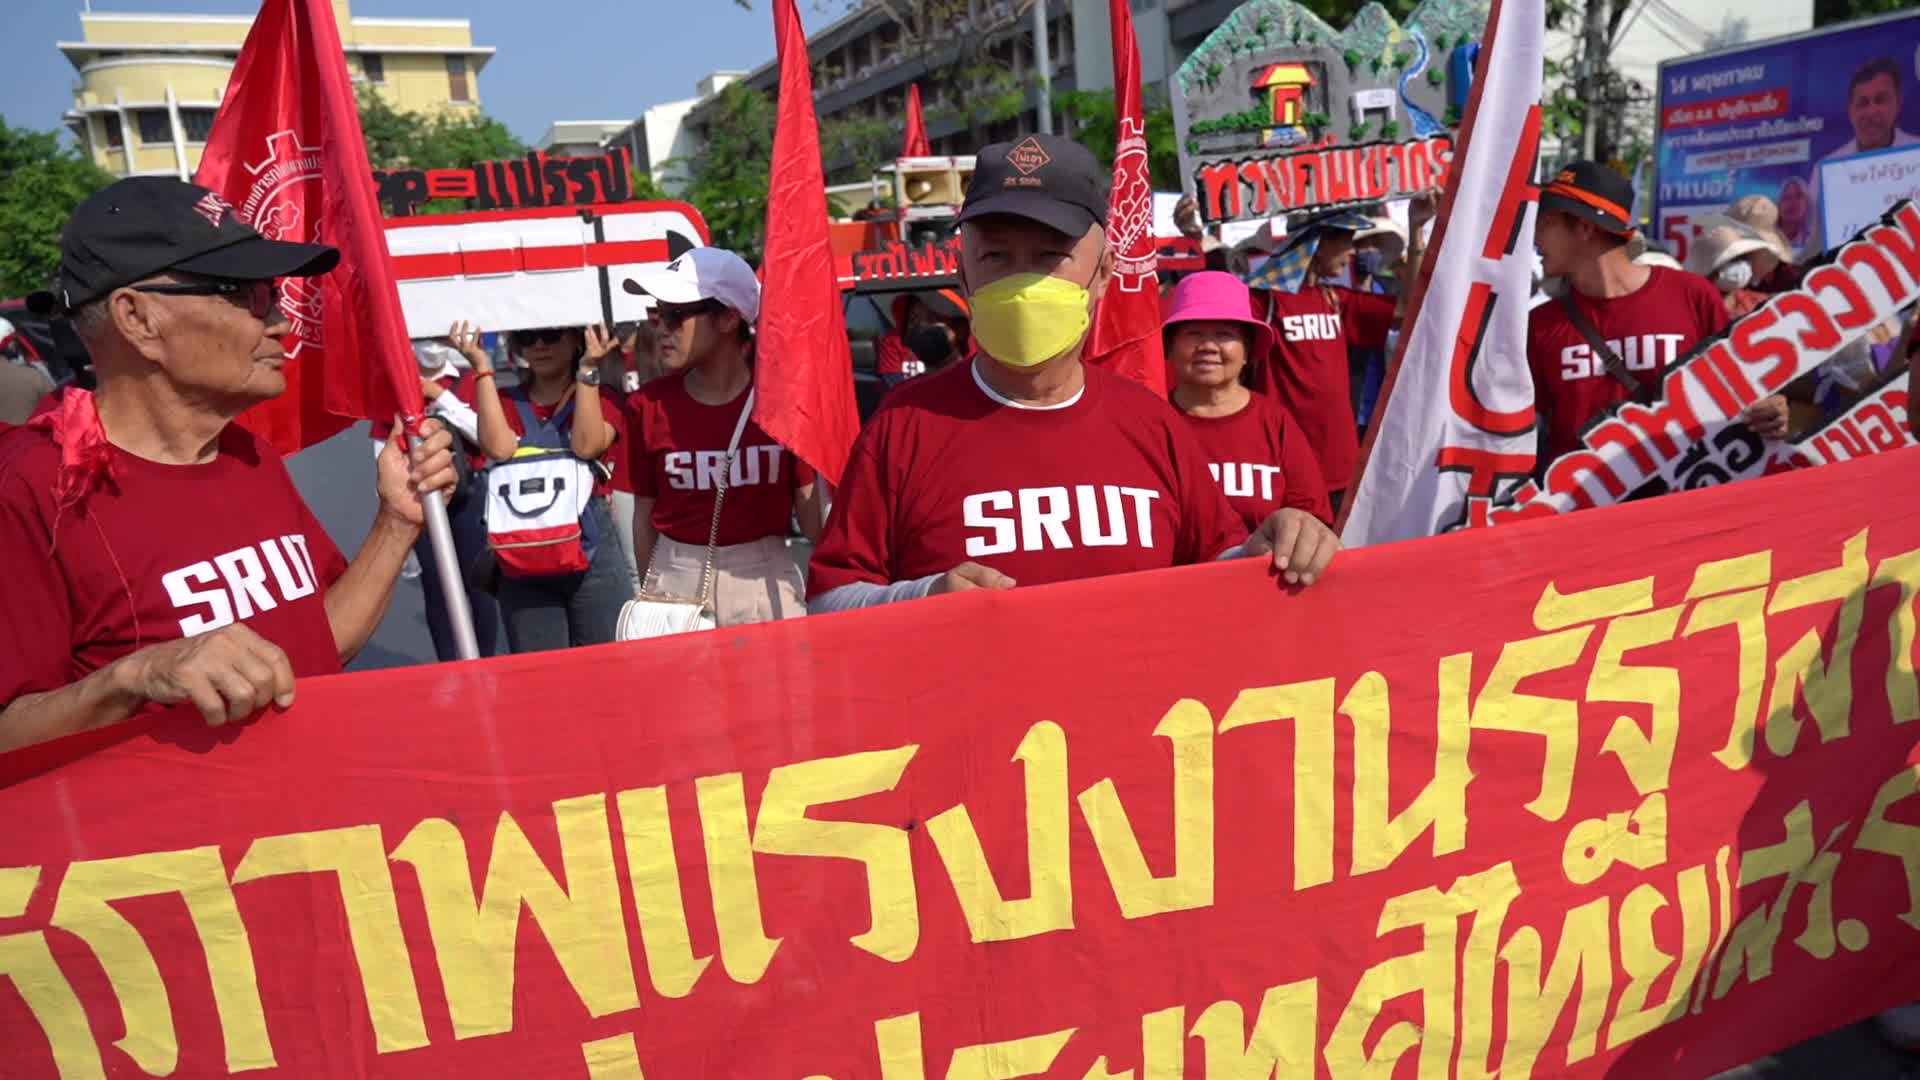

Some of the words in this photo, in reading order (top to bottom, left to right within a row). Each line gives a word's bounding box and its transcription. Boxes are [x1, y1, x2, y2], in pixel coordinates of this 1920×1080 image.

[664, 445, 785, 490] SRUT
[1208, 461, 1281, 501] UT
[963, 484, 1161, 558] SRUT
[161, 533, 319, 638] SRUT
